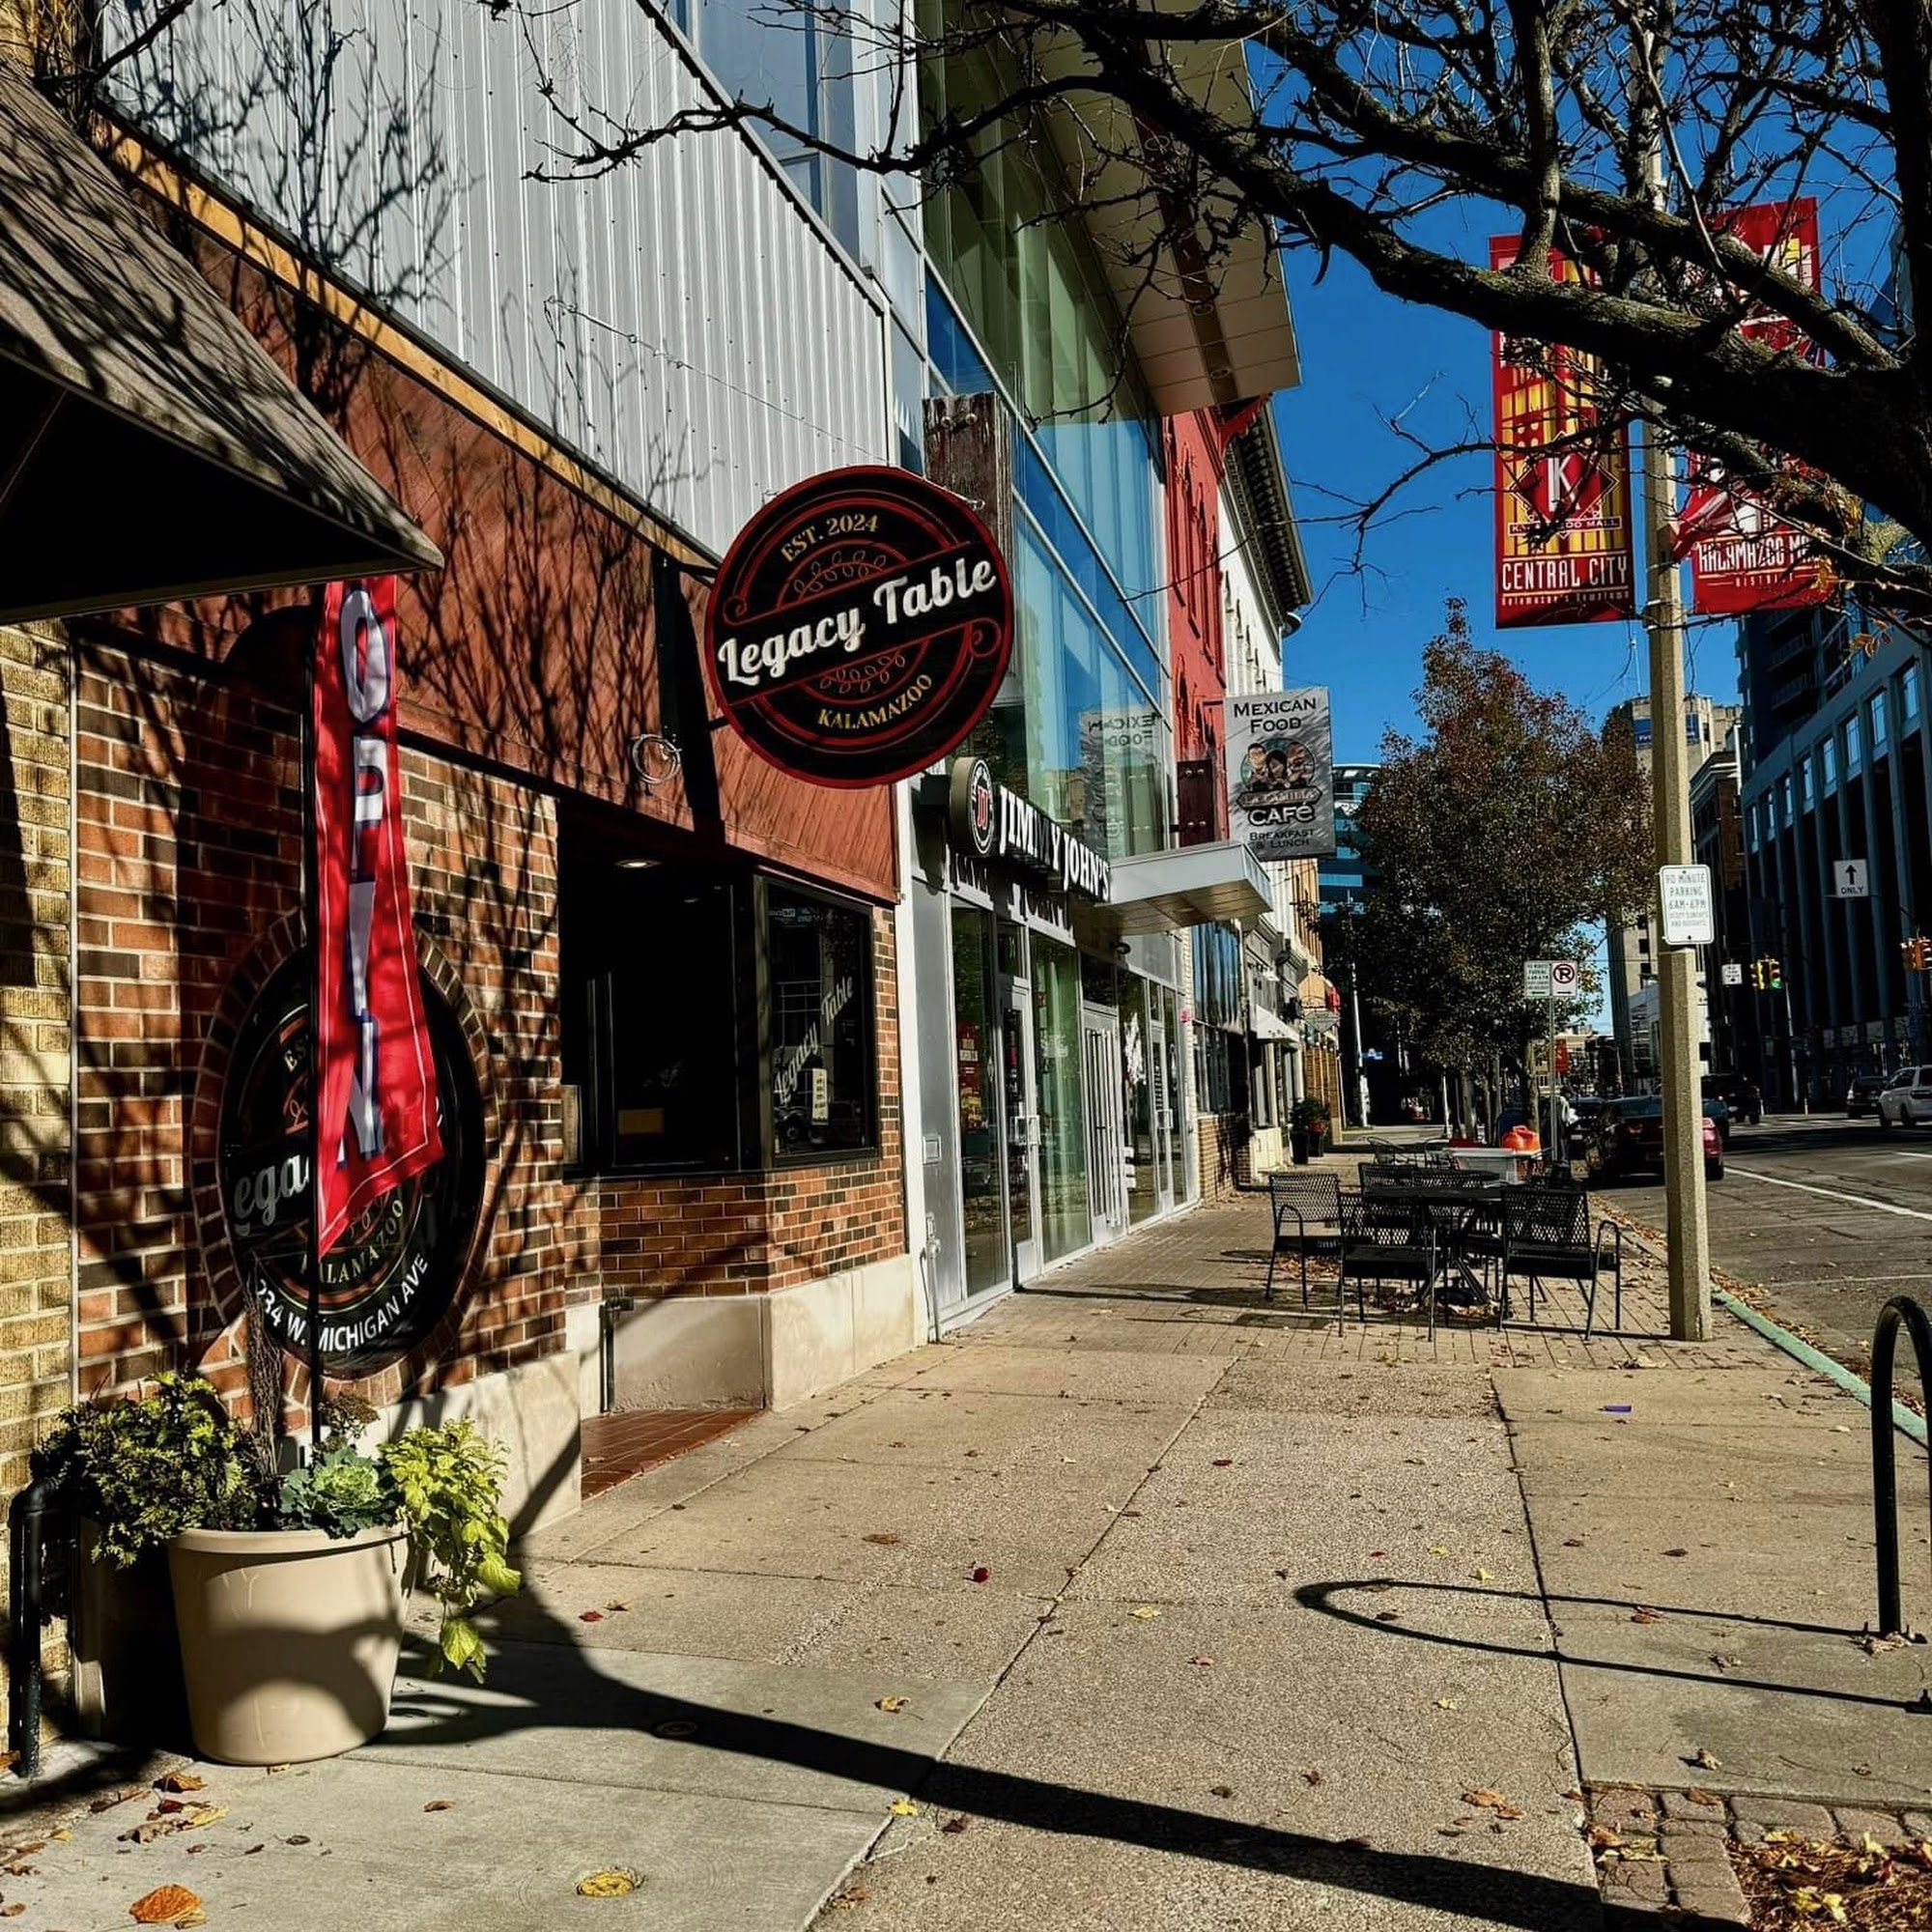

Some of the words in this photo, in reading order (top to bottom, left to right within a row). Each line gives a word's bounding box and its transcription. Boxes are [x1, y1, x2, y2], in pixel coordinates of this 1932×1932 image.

[780, 524, 825, 563] EST.
[826, 514, 879, 535] 2024
[1502, 559, 1580, 591] CENTRAL
[1589, 555, 1627, 585] CITY
[718, 608, 866, 687] Legacy
[873, 557, 997, 625] Table
[818, 674, 932, 729] KALAMAZOO
[1234, 698, 1317, 718] MEXICAN
[1250, 718, 1301, 734] FOOD
[1000, 784, 1062, 871] JIMMY
[1064, 832, 1111, 903] JOHN'S
[1250, 829, 1314, 841] BREAKFAST
[1270, 838, 1310, 849] LUNCH
[1669, 886, 1703, 896] PARKING
[1841, 886, 1864, 895] ONLY
[774, 1021, 819, 1106] Legacy
[821, 975, 853, 1027] Table
[286, 1312, 306, 1346] W.
[401, 1253, 429, 1304] AVE
